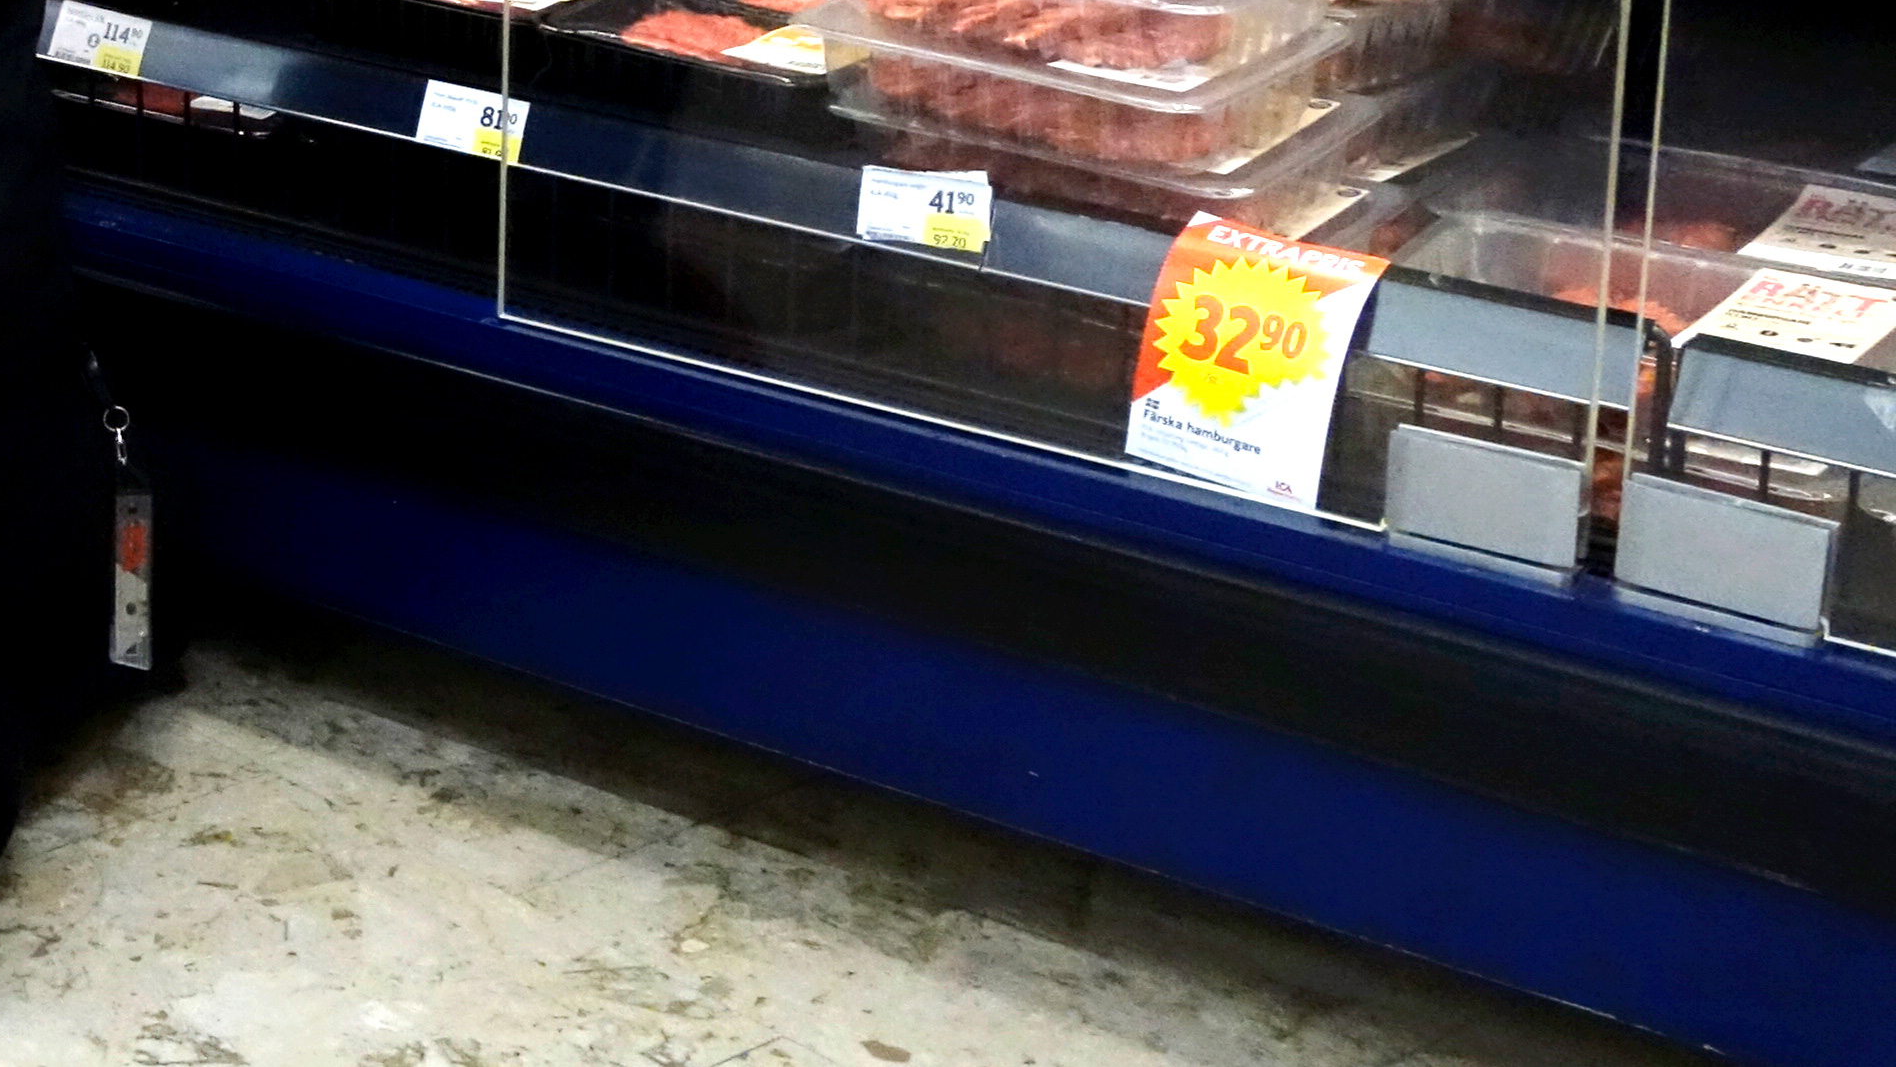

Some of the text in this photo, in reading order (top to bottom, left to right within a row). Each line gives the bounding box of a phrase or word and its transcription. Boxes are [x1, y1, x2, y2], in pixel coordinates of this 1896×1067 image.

[929, 189, 955, 215] 41
[1206, 224, 1367, 274] EXTRAPRIS
[1178, 294, 1261, 376] 32
[1142, 408, 1262, 456] Färska hamburgare
